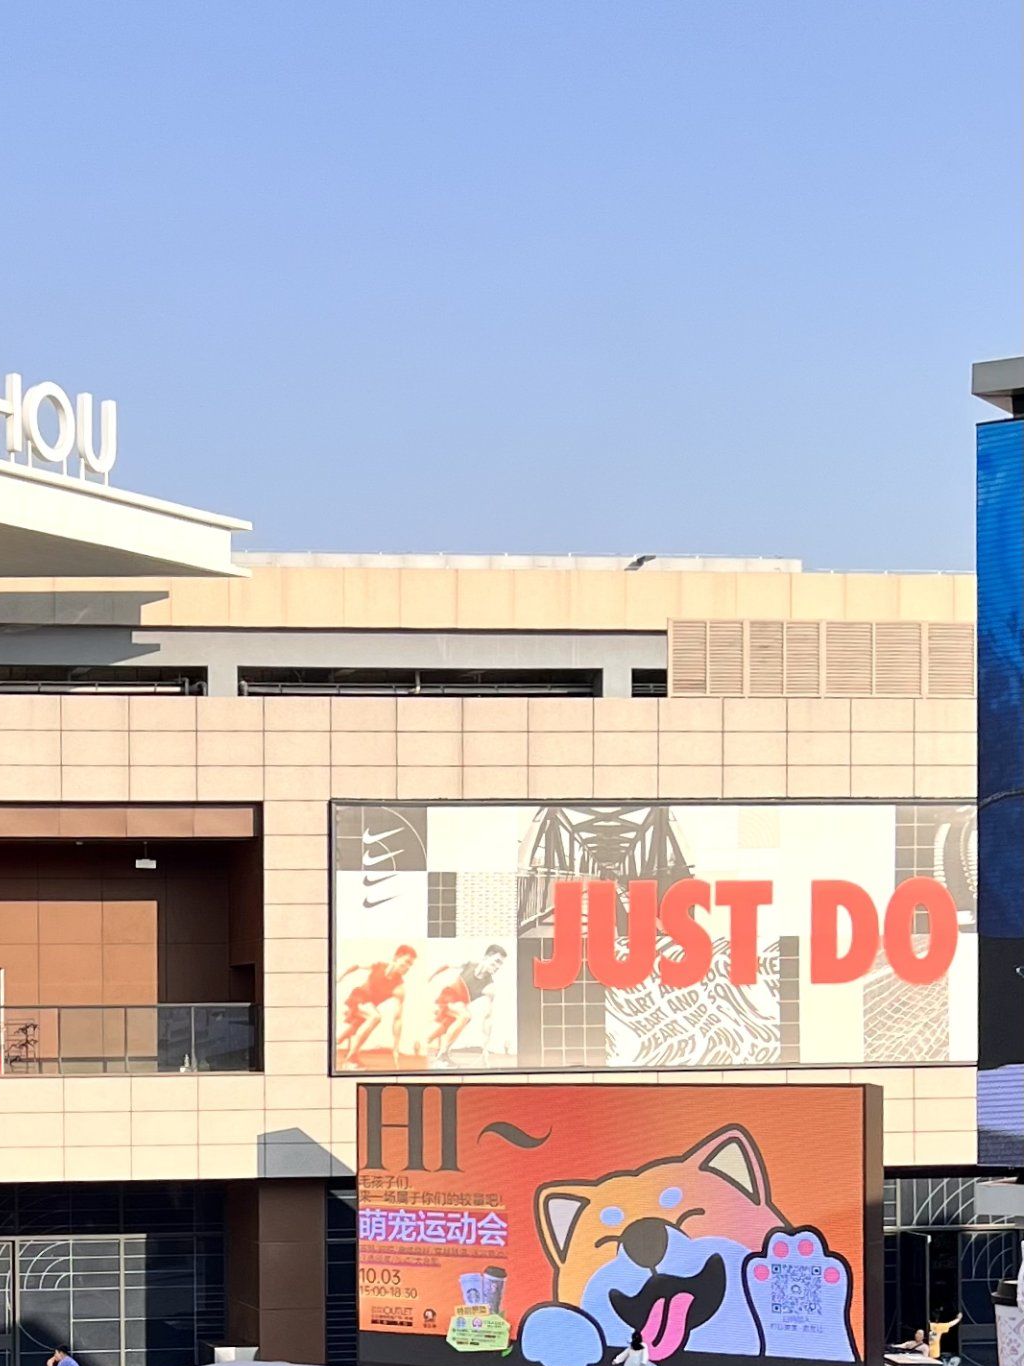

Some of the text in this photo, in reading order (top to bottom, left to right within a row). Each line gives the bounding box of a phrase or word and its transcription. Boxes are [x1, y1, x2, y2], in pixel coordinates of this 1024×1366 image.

[533, 877, 959, 989] JUST DO
[667, 990, 699, 1014] AND
[358, 1209, 507, 1247] 萌宠运动会
[360, 1267, 401, 1285] 10.03
